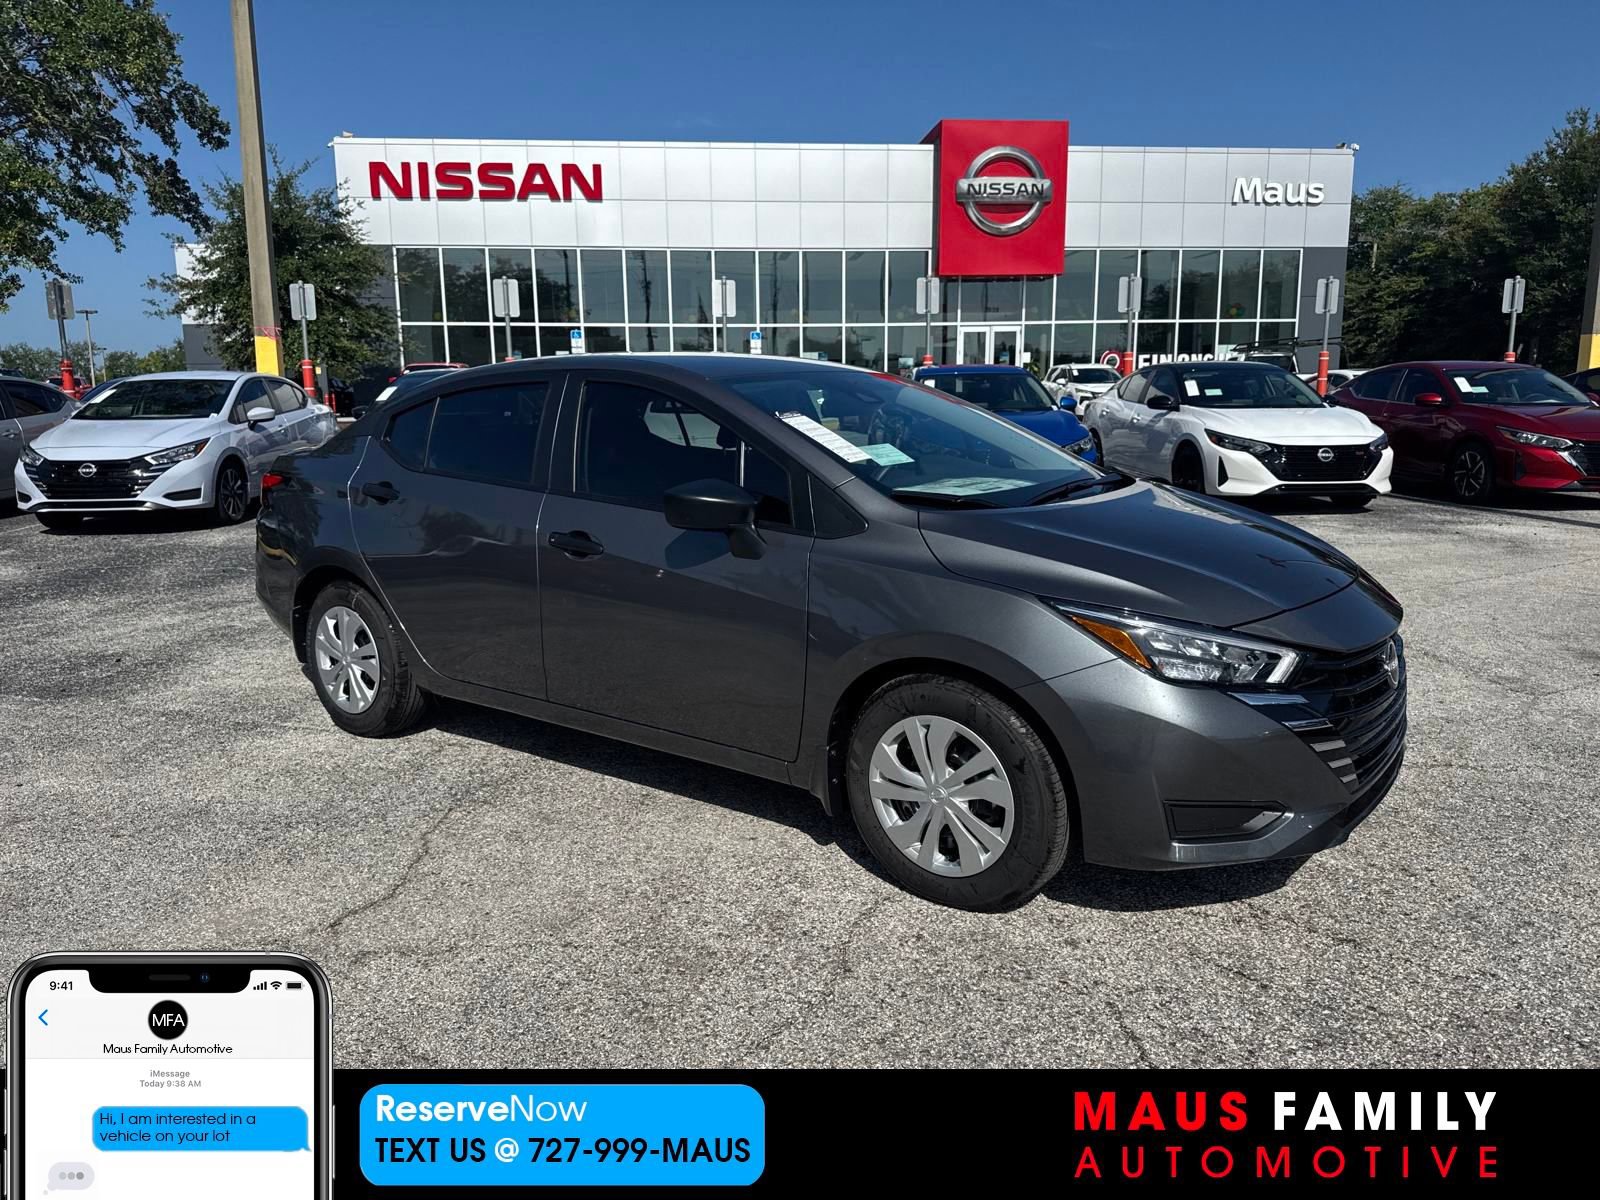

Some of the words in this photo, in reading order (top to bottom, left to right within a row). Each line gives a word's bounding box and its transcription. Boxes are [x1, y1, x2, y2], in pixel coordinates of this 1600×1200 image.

[368, 161, 604, 203] NISSAN
[966, 182, 1045, 197] NISSAN
[1231, 176, 1325, 207] Maus
